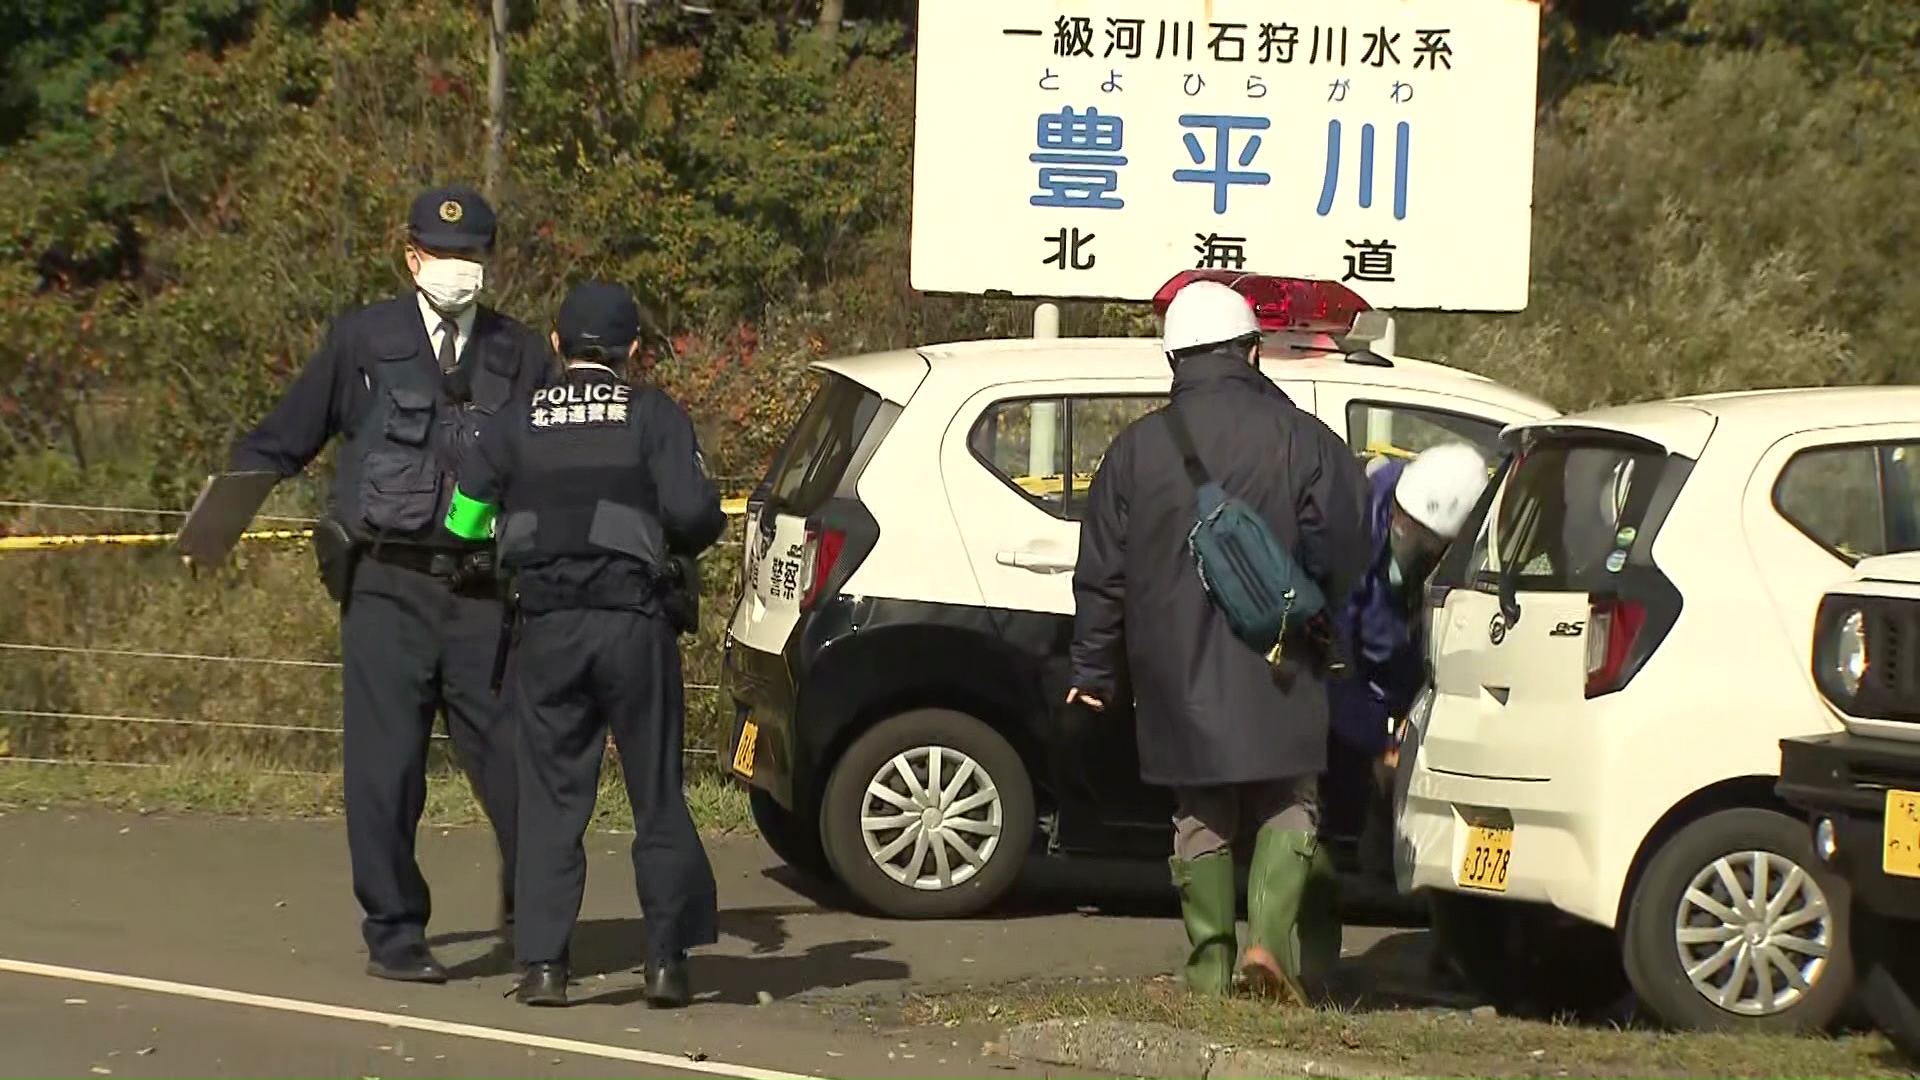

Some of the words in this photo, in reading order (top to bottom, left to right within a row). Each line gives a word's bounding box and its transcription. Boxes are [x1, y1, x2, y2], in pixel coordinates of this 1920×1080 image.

[1002, 15, 1454, 71] 一級河川石狩川水系
[531, 383, 632, 406] POLICE
[531, 403, 628, 427] 北海道警察
